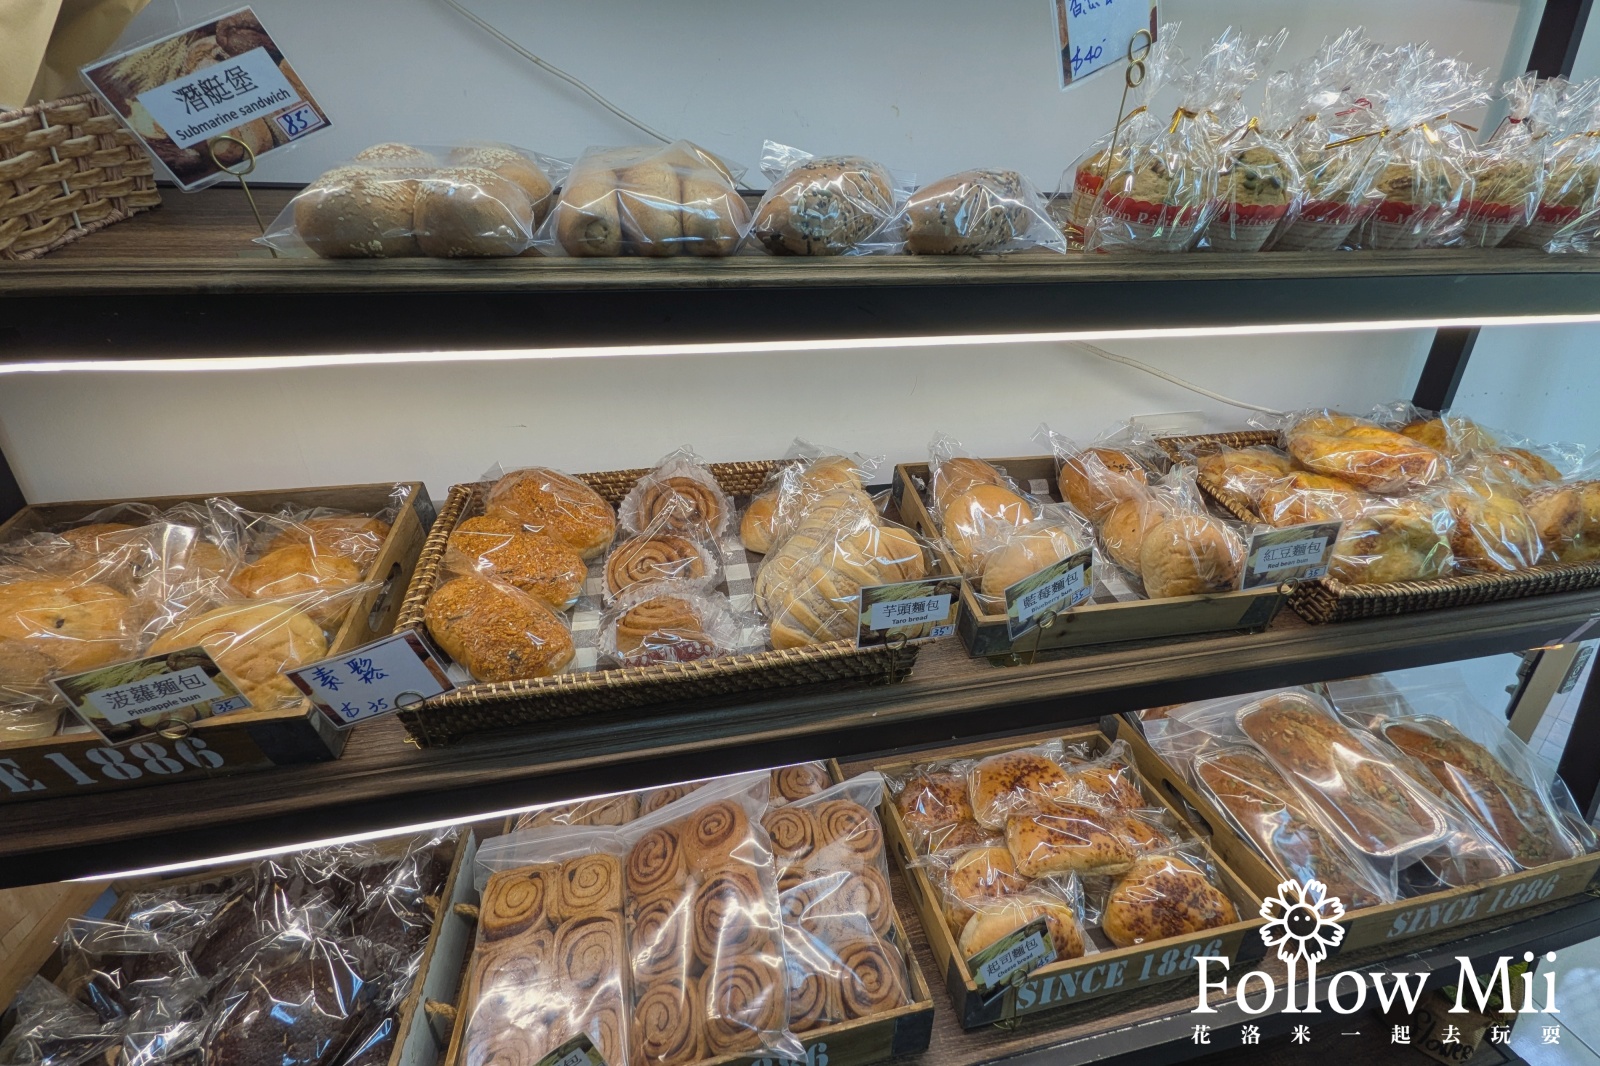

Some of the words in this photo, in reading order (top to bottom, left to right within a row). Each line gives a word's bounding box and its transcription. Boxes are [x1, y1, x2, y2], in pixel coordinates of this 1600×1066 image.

[172, 65, 259, 115] 潛艇堡
[176, 110, 239, 141] Submarine
[238, 88, 292, 116] sandwich
[1263, 541, 1322, 562] 紅豆麵包
[882, 599, 940, 618] 芋頭麵包
[908, 615, 929, 623] bread
[1031, 595, 1060, 613] Blueberry
[1060, 588, 1073, 597] bun
[101, 673, 207, 710] 菠蘿麵包
[127, 698, 179, 717] Pineapple
[181, 693, 201, 706] bun
[43, 736, 225, 786] 1886
[1386, 893, 1487, 938] SINCE
[1486, 874, 1560, 914] 1886
[986, 938, 1039, 977] 起司麵包
[997, 963, 1017, 978] Cheese
[1017, 952, 1034, 966] bread
[1015, 959, 1129, 1010] SINCE
[1138, 938, 1224, 982] 1886
